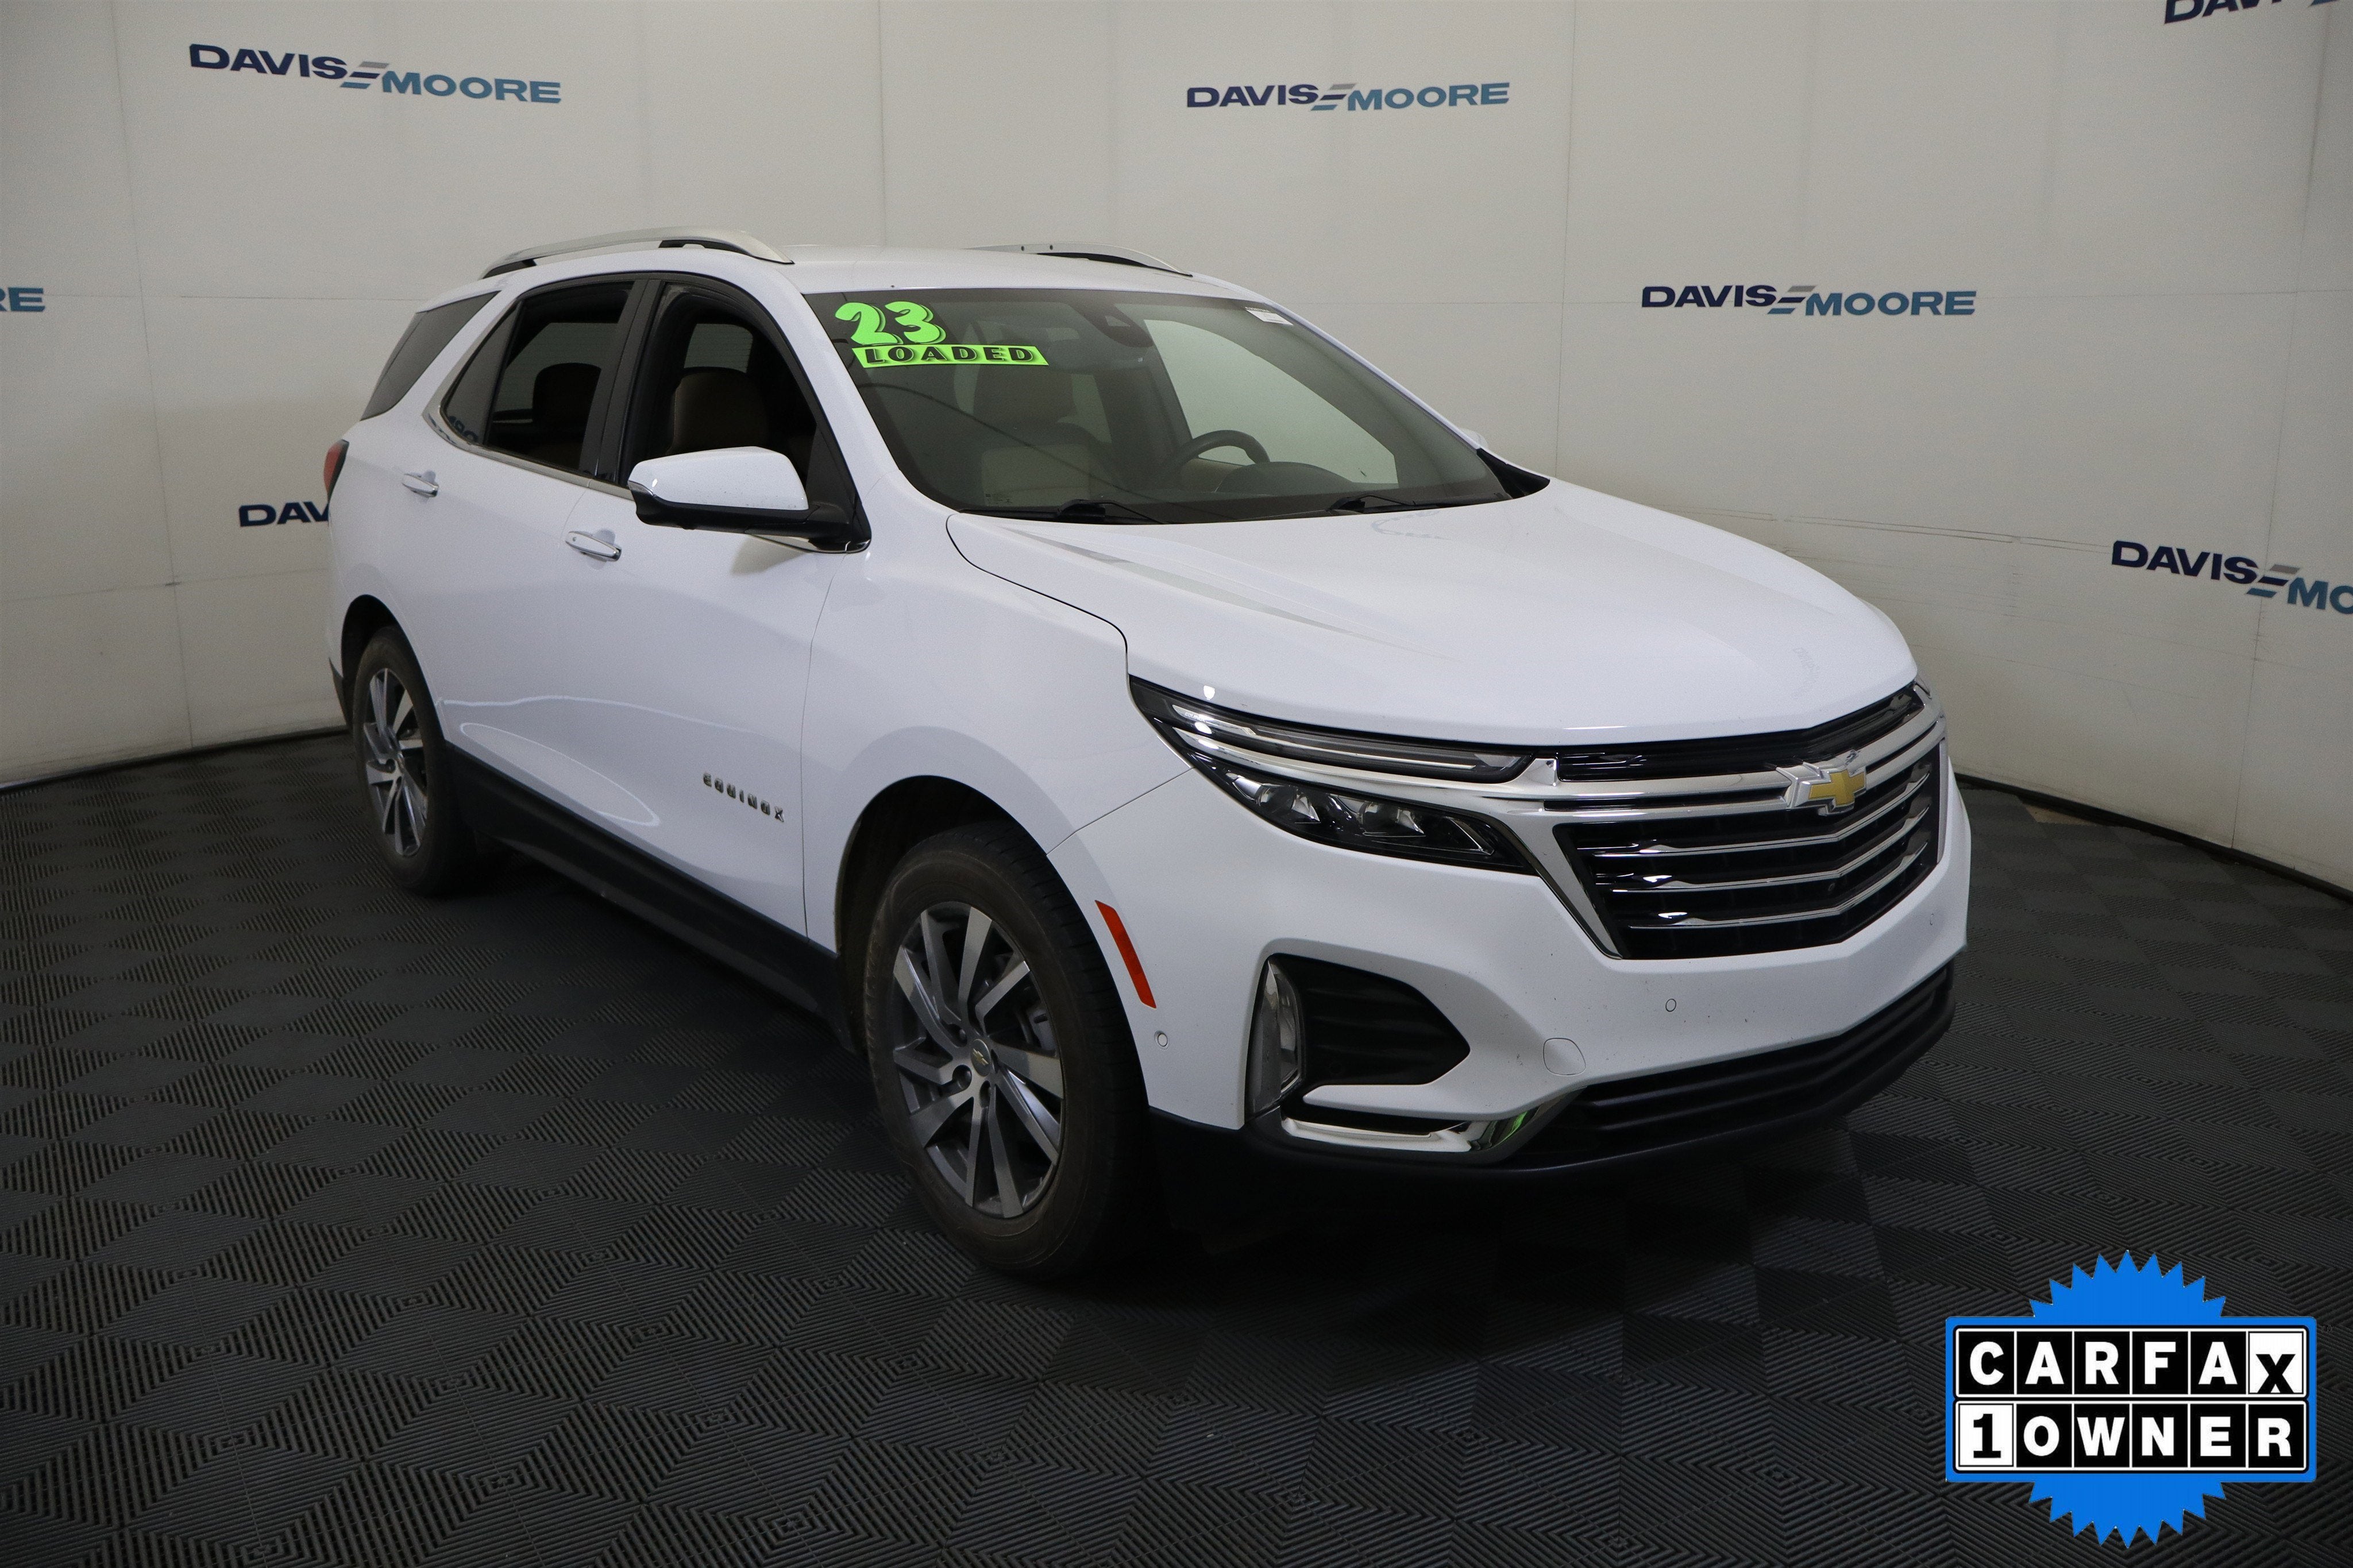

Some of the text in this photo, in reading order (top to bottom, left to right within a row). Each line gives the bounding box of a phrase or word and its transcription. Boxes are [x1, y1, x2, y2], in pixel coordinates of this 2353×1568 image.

[189, 44, 562, 104] DAVIS MOORE
[1186, 82, 1510, 111] DAVIS MOORE
[834, 300, 947, 345] 23
[1641, 284, 1977, 316] DAVIS MOORE
[863, 345, 1035, 364] LOADED
[2111, 540, 2259, 585] DAVIS
[703, 772, 785, 822] EQUINOX
